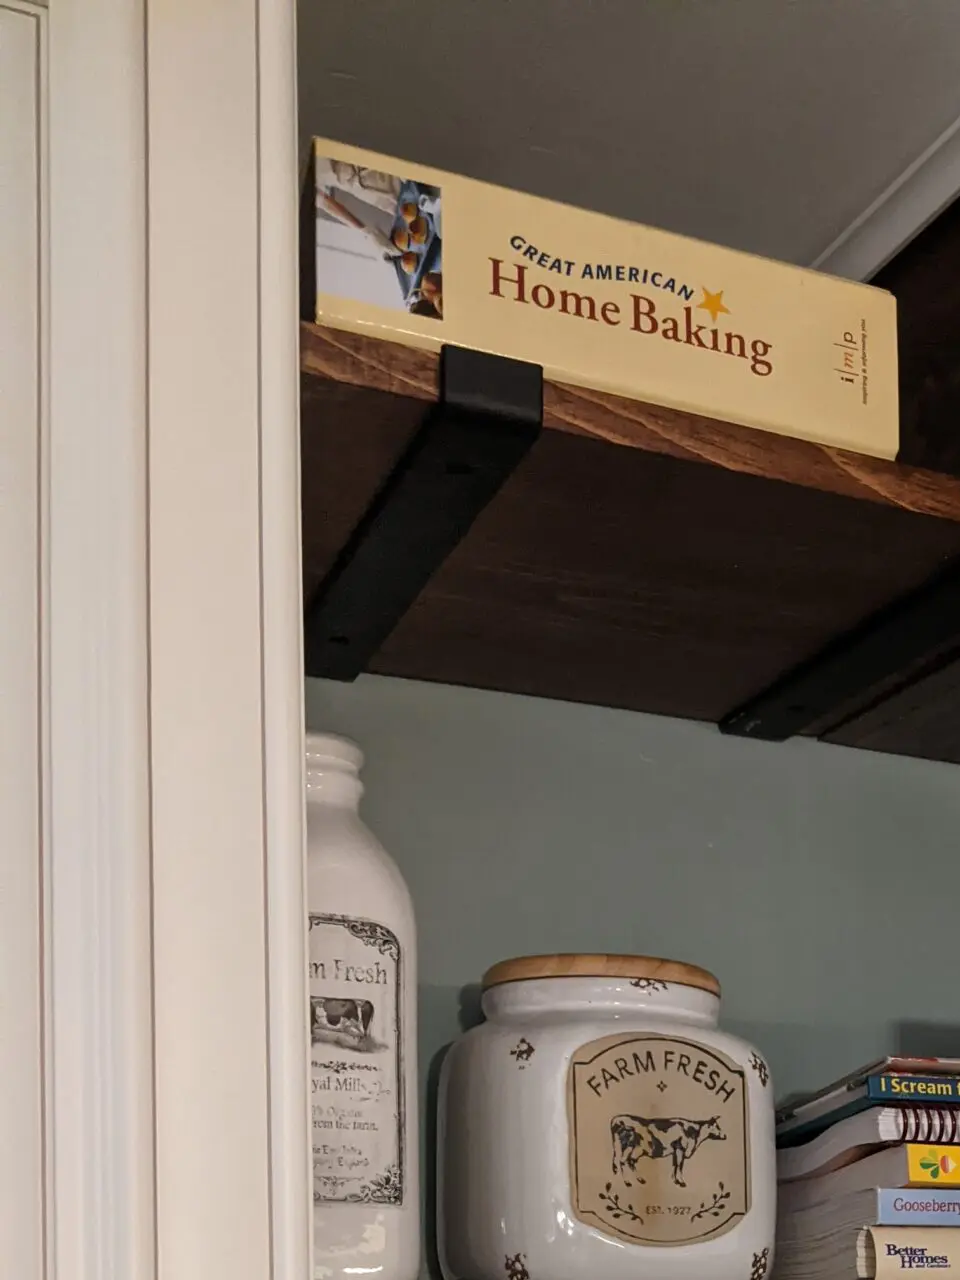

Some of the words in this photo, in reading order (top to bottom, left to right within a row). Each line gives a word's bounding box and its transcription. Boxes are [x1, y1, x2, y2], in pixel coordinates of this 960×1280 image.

[509, 235, 576, 277] GREAT
[581, 263, 695, 301] AMERICAN
[487, 257, 621, 326] Home
[629, 293, 773, 376] Baking
[333, 959, 387, 985] Fresh
[586, 1050, 656, 1098] FARM
[664, 1050, 736, 1103] FRESH
[880, 1077, 886, 1092] I
[891, 1077, 952, 1096] Scream
[646, 1205, 664, 1215] EST.
[667, 1206, 692, 1216] 1927
[885, 1243, 928, 1256] Better
[900, 1255, 949, 1269] Homes
